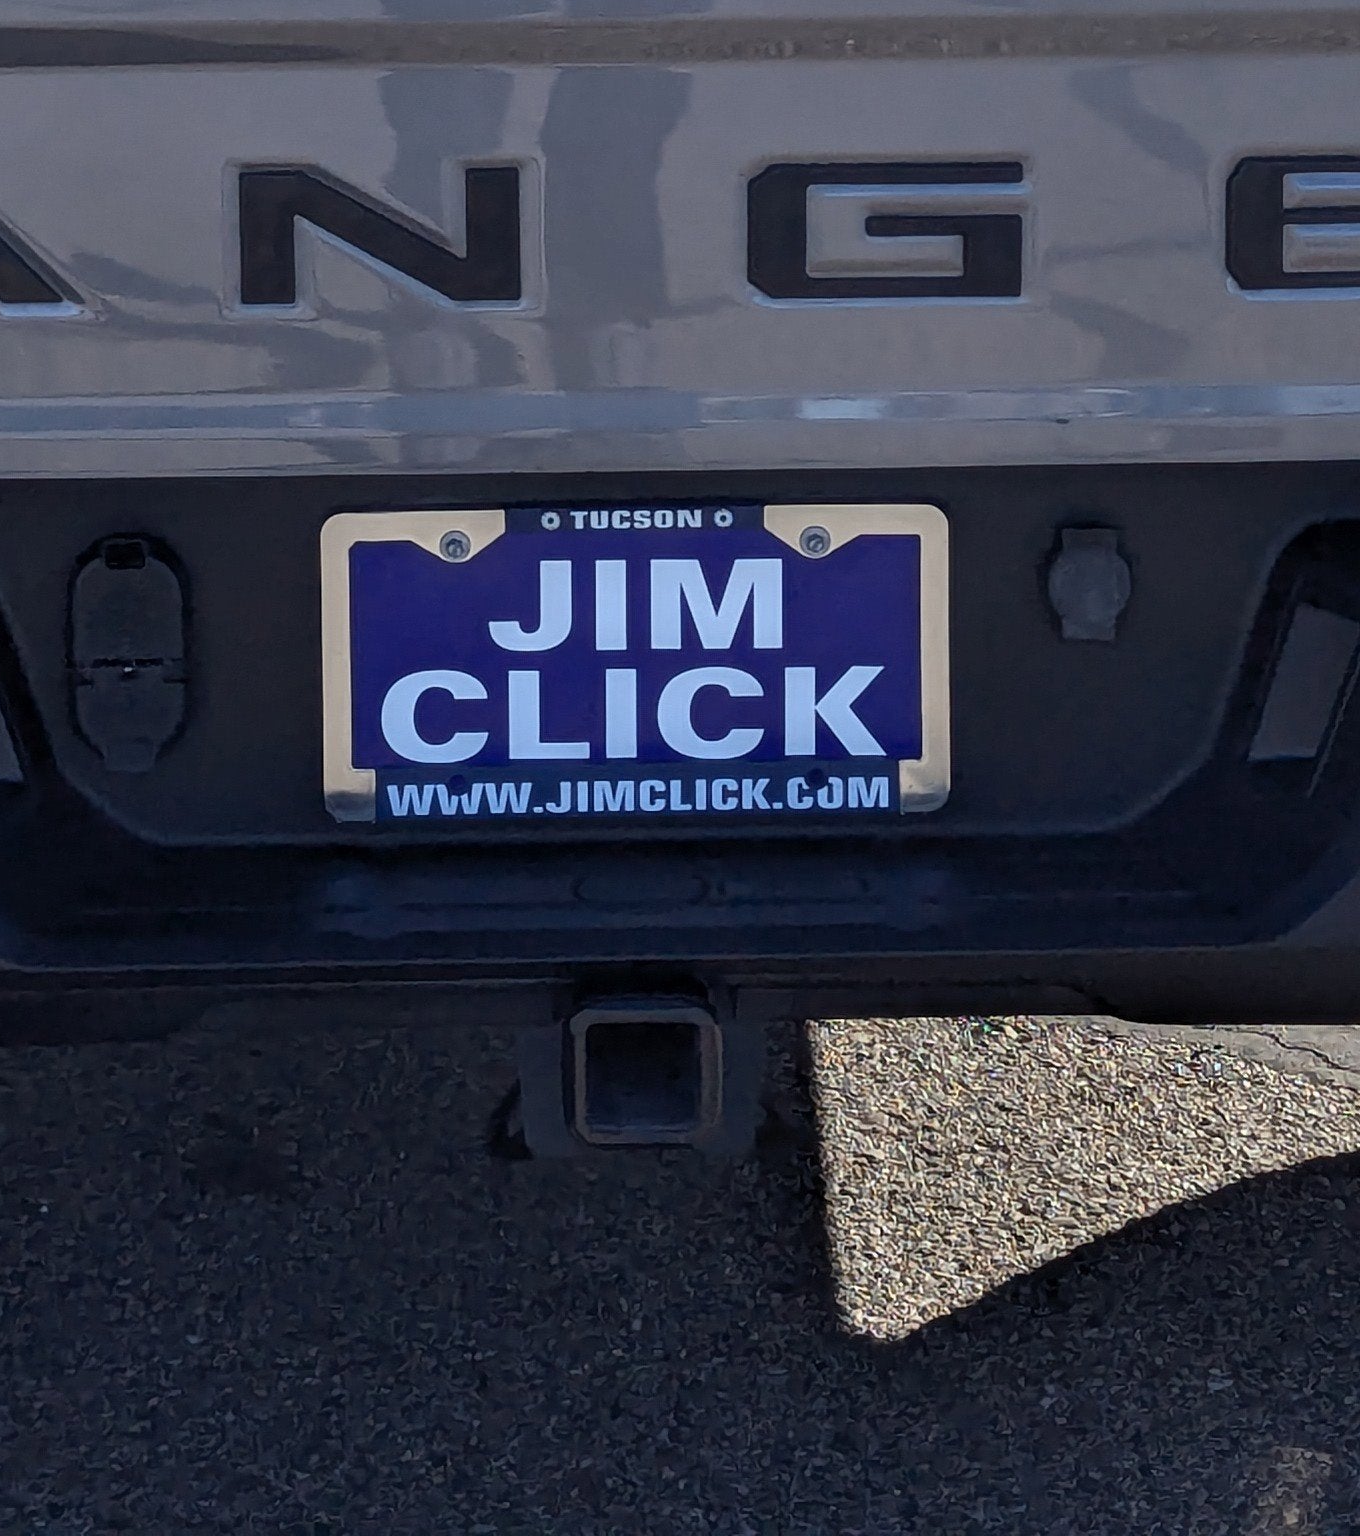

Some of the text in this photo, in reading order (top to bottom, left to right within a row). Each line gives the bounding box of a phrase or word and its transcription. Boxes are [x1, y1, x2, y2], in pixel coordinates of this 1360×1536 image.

[570, 510, 702, 530] TUCSON
[488, 558, 783, 652] JIM
[380, 665, 887, 764] CLICK
[386, 776, 891, 816] WWW.JIMCLICK.COM
